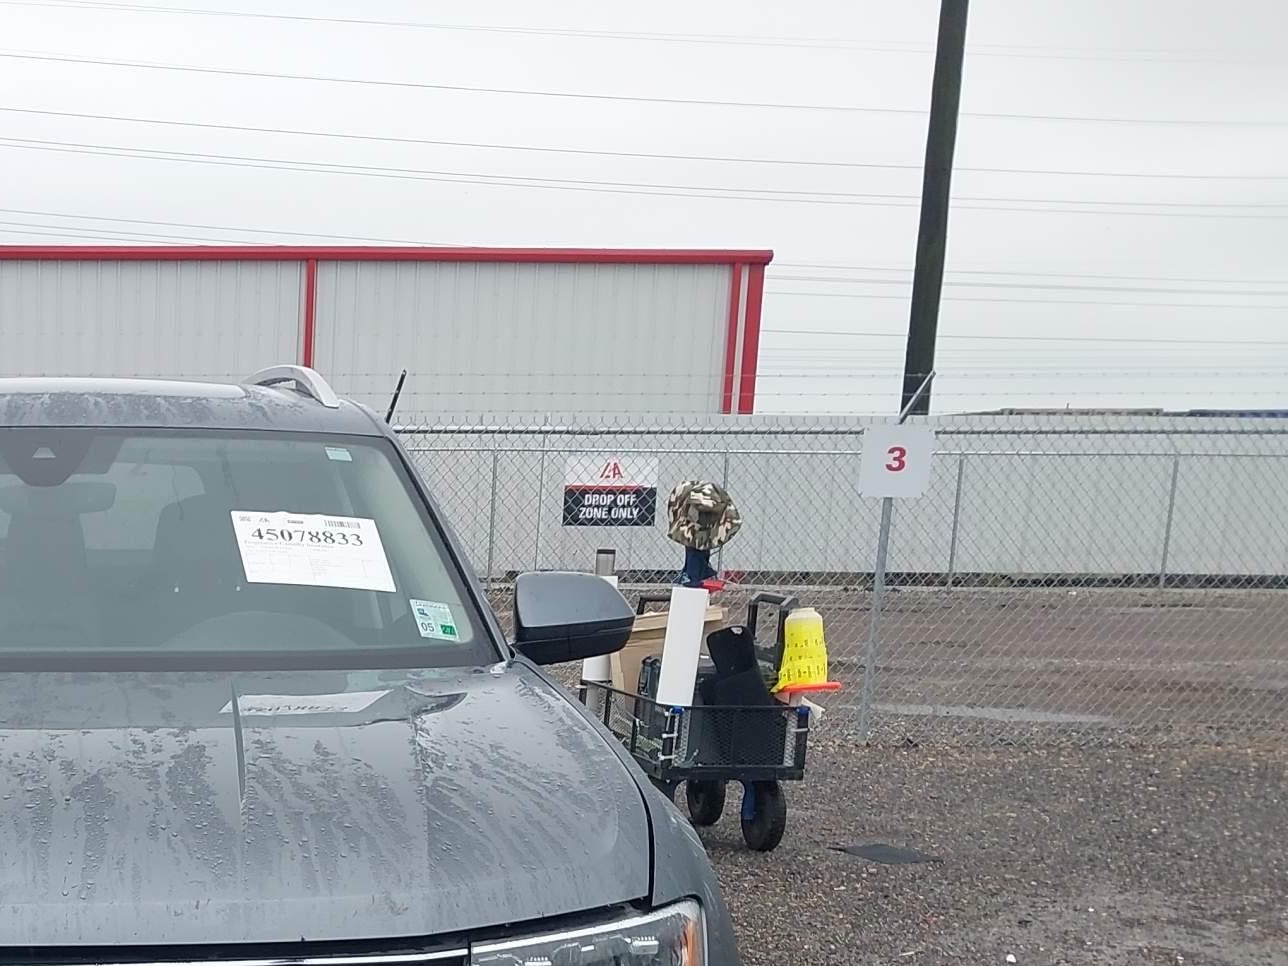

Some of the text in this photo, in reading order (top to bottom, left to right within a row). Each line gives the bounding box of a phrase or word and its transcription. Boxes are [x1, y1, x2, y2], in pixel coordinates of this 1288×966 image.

[885, 446, 907, 472] 3
[584, 494, 637, 506] DROP OFF
[578, 507, 641, 519] ZONE ONLY
[251, 527, 364, 547] 45078833
[420, 622, 435, 632] 05
